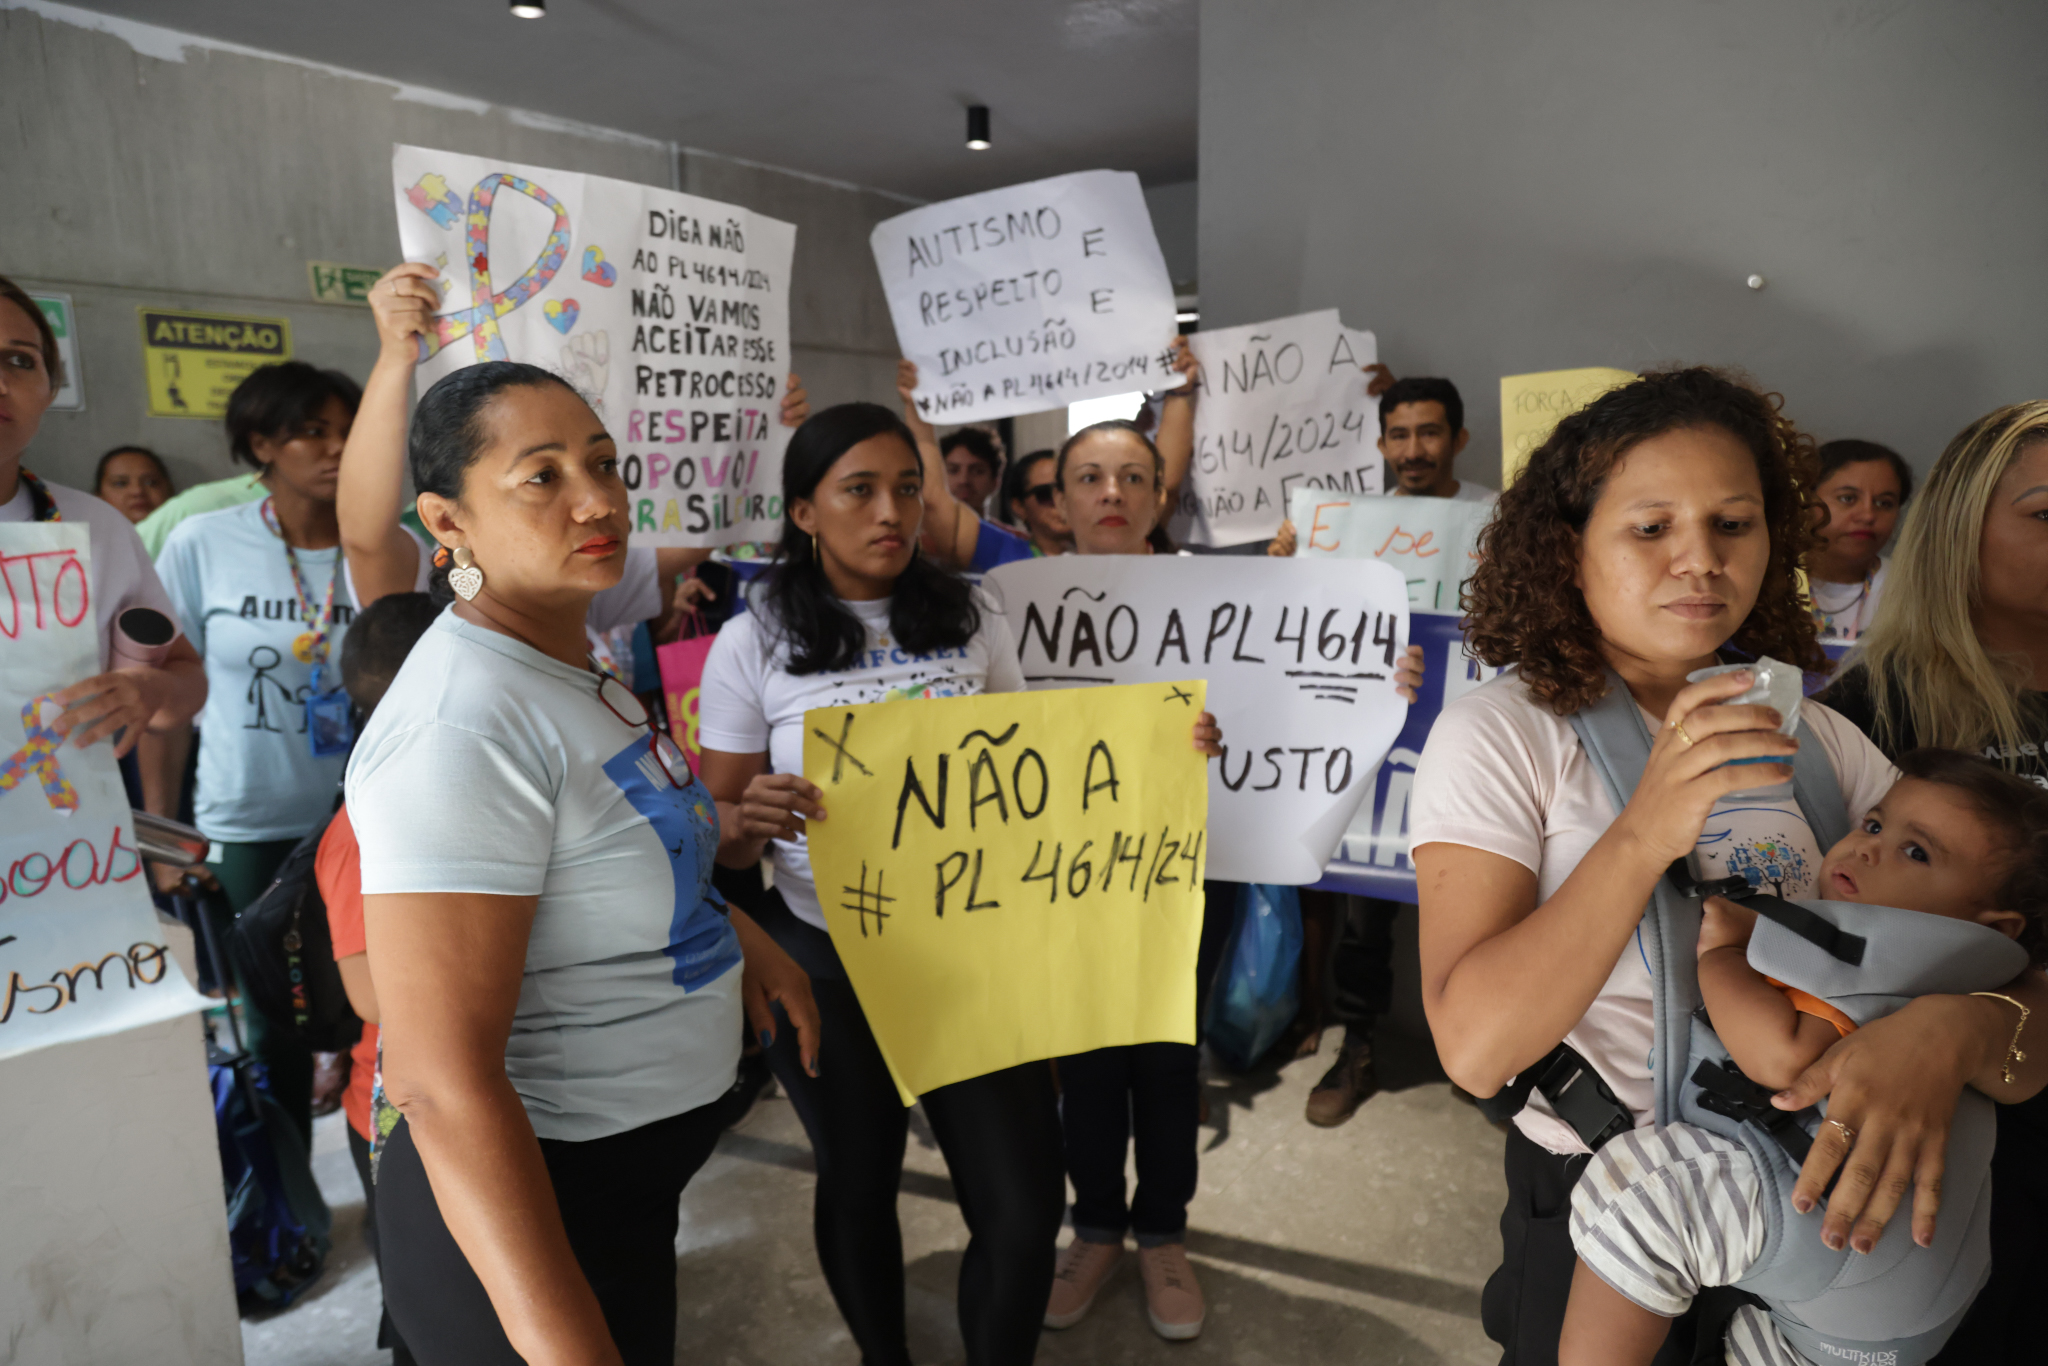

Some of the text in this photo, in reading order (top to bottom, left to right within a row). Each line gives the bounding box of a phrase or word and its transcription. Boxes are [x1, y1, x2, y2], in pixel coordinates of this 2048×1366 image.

[648, 208, 745, 253] DIGA NÃO
[907, 206, 1108, 278] AUTISMO E
[632, 248, 658, 273] AO
[669, 255, 688, 279] PL
[632, 282, 761, 331] NÃO VAMOS
[919, 268, 1115, 327] RESPEITO E
[154, 320, 279, 351] ATENÇÃO
[632, 322, 776, 363] ACEITAR ESSE
[938, 318, 1076, 377] INCLUSÃO
[636, 365, 776, 400] RETROCESSO
[1003, 378, 1026, 398] PL
[1222, 334, 1304, 395] NÃO
[1327, 333, 1360, 375] A
[628, 408, 768, 444] RESPEITA
[1513, 388, 1575, 418] FORÇA
[1199, 412, 1365, 477] 614/2024
[646, 450, 759, 497] POVO!
[626, 493, 784, 534] RASILEIRO
[1253, 486, 1272, 511] A
[1308, 501, 1352, 553] E
[1374, 525, 1440, 558] se
[1018, 587, 1398, 668] NÃO A PL 4614
[891, 722, 1120, 851] NÃO A
[1219, 746, 1353, 795] USTO
[840, 826, 1204, 938] # PL 4614/24
